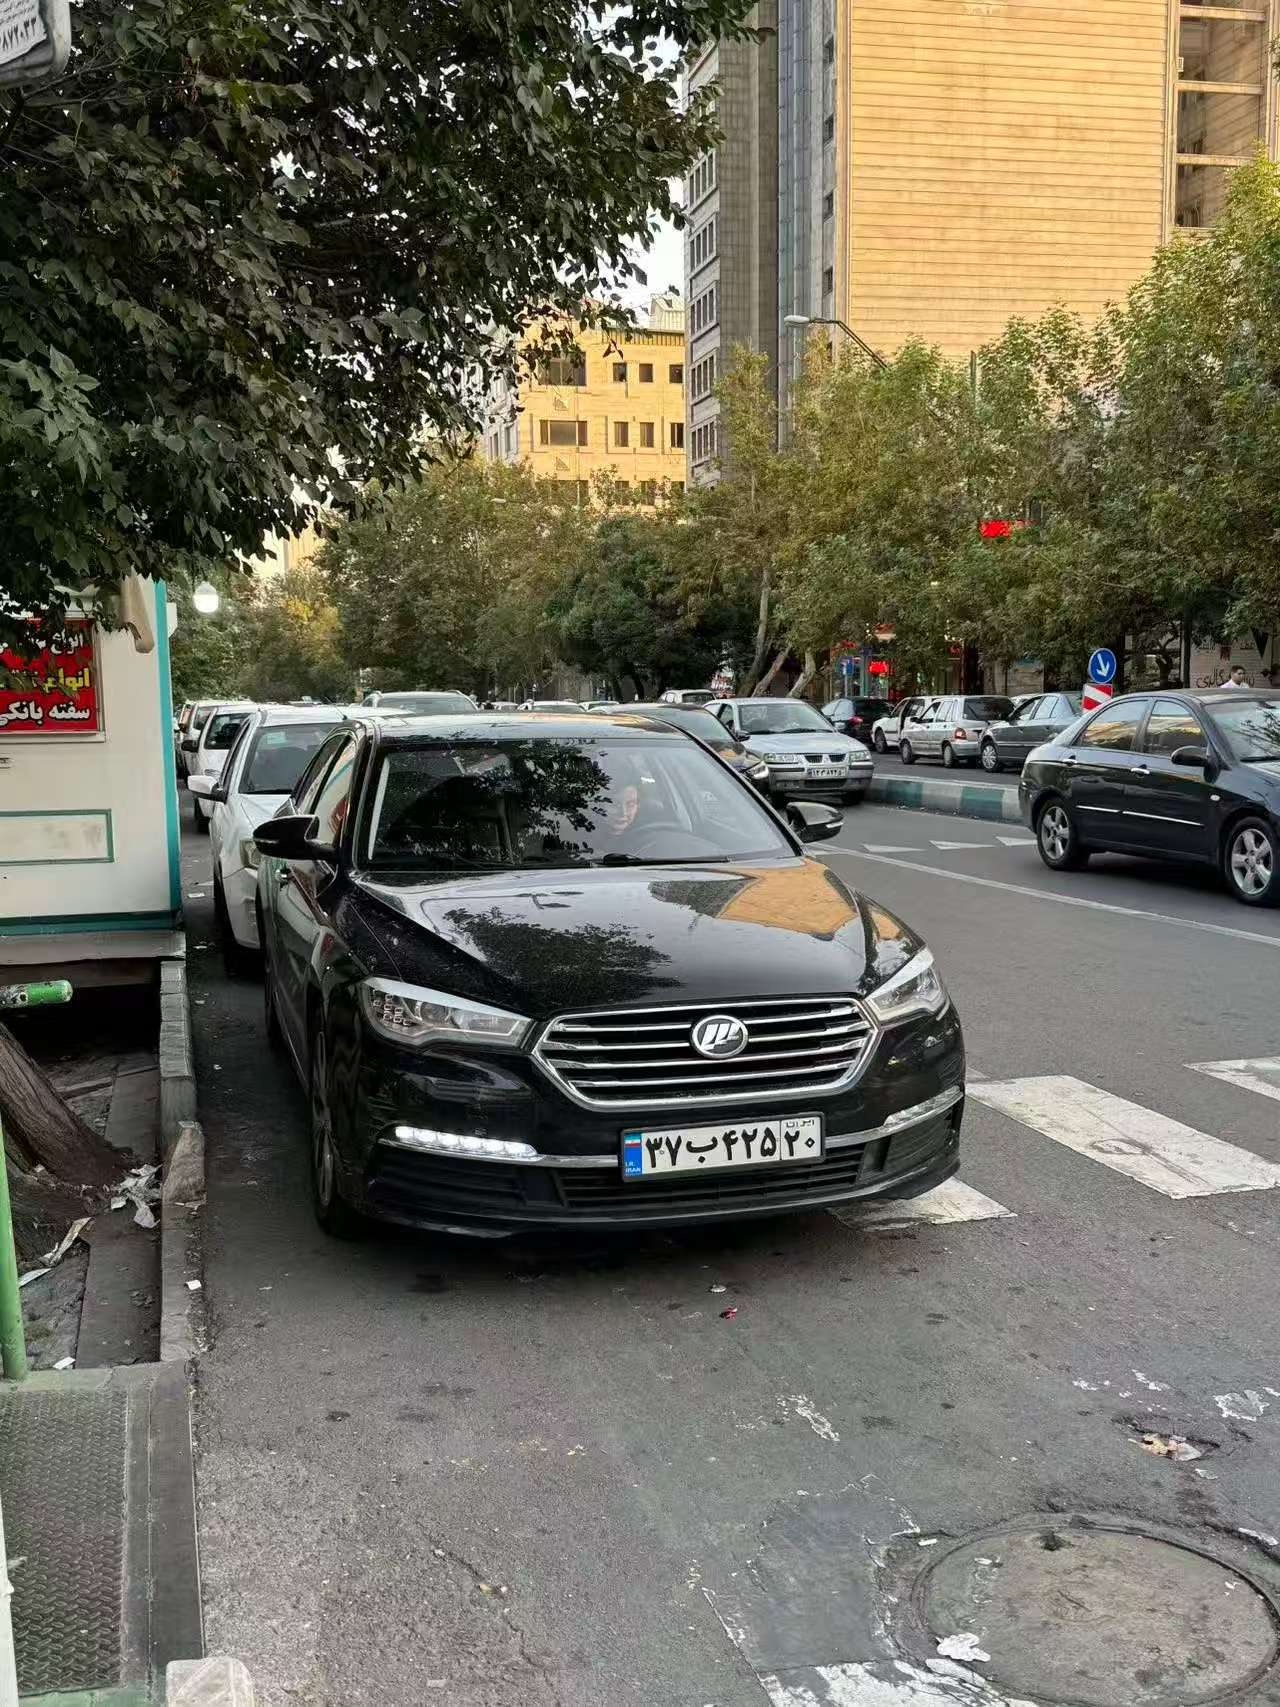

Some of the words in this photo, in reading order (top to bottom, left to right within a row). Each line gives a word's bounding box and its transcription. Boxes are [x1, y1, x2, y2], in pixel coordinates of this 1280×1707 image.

[43, 667, 91, 694] انواع
[48, 701, 90, 720] سفته
[786, 1119, 815, 1128] ایران
[784, 1129, 816, 1157] ۲۰
